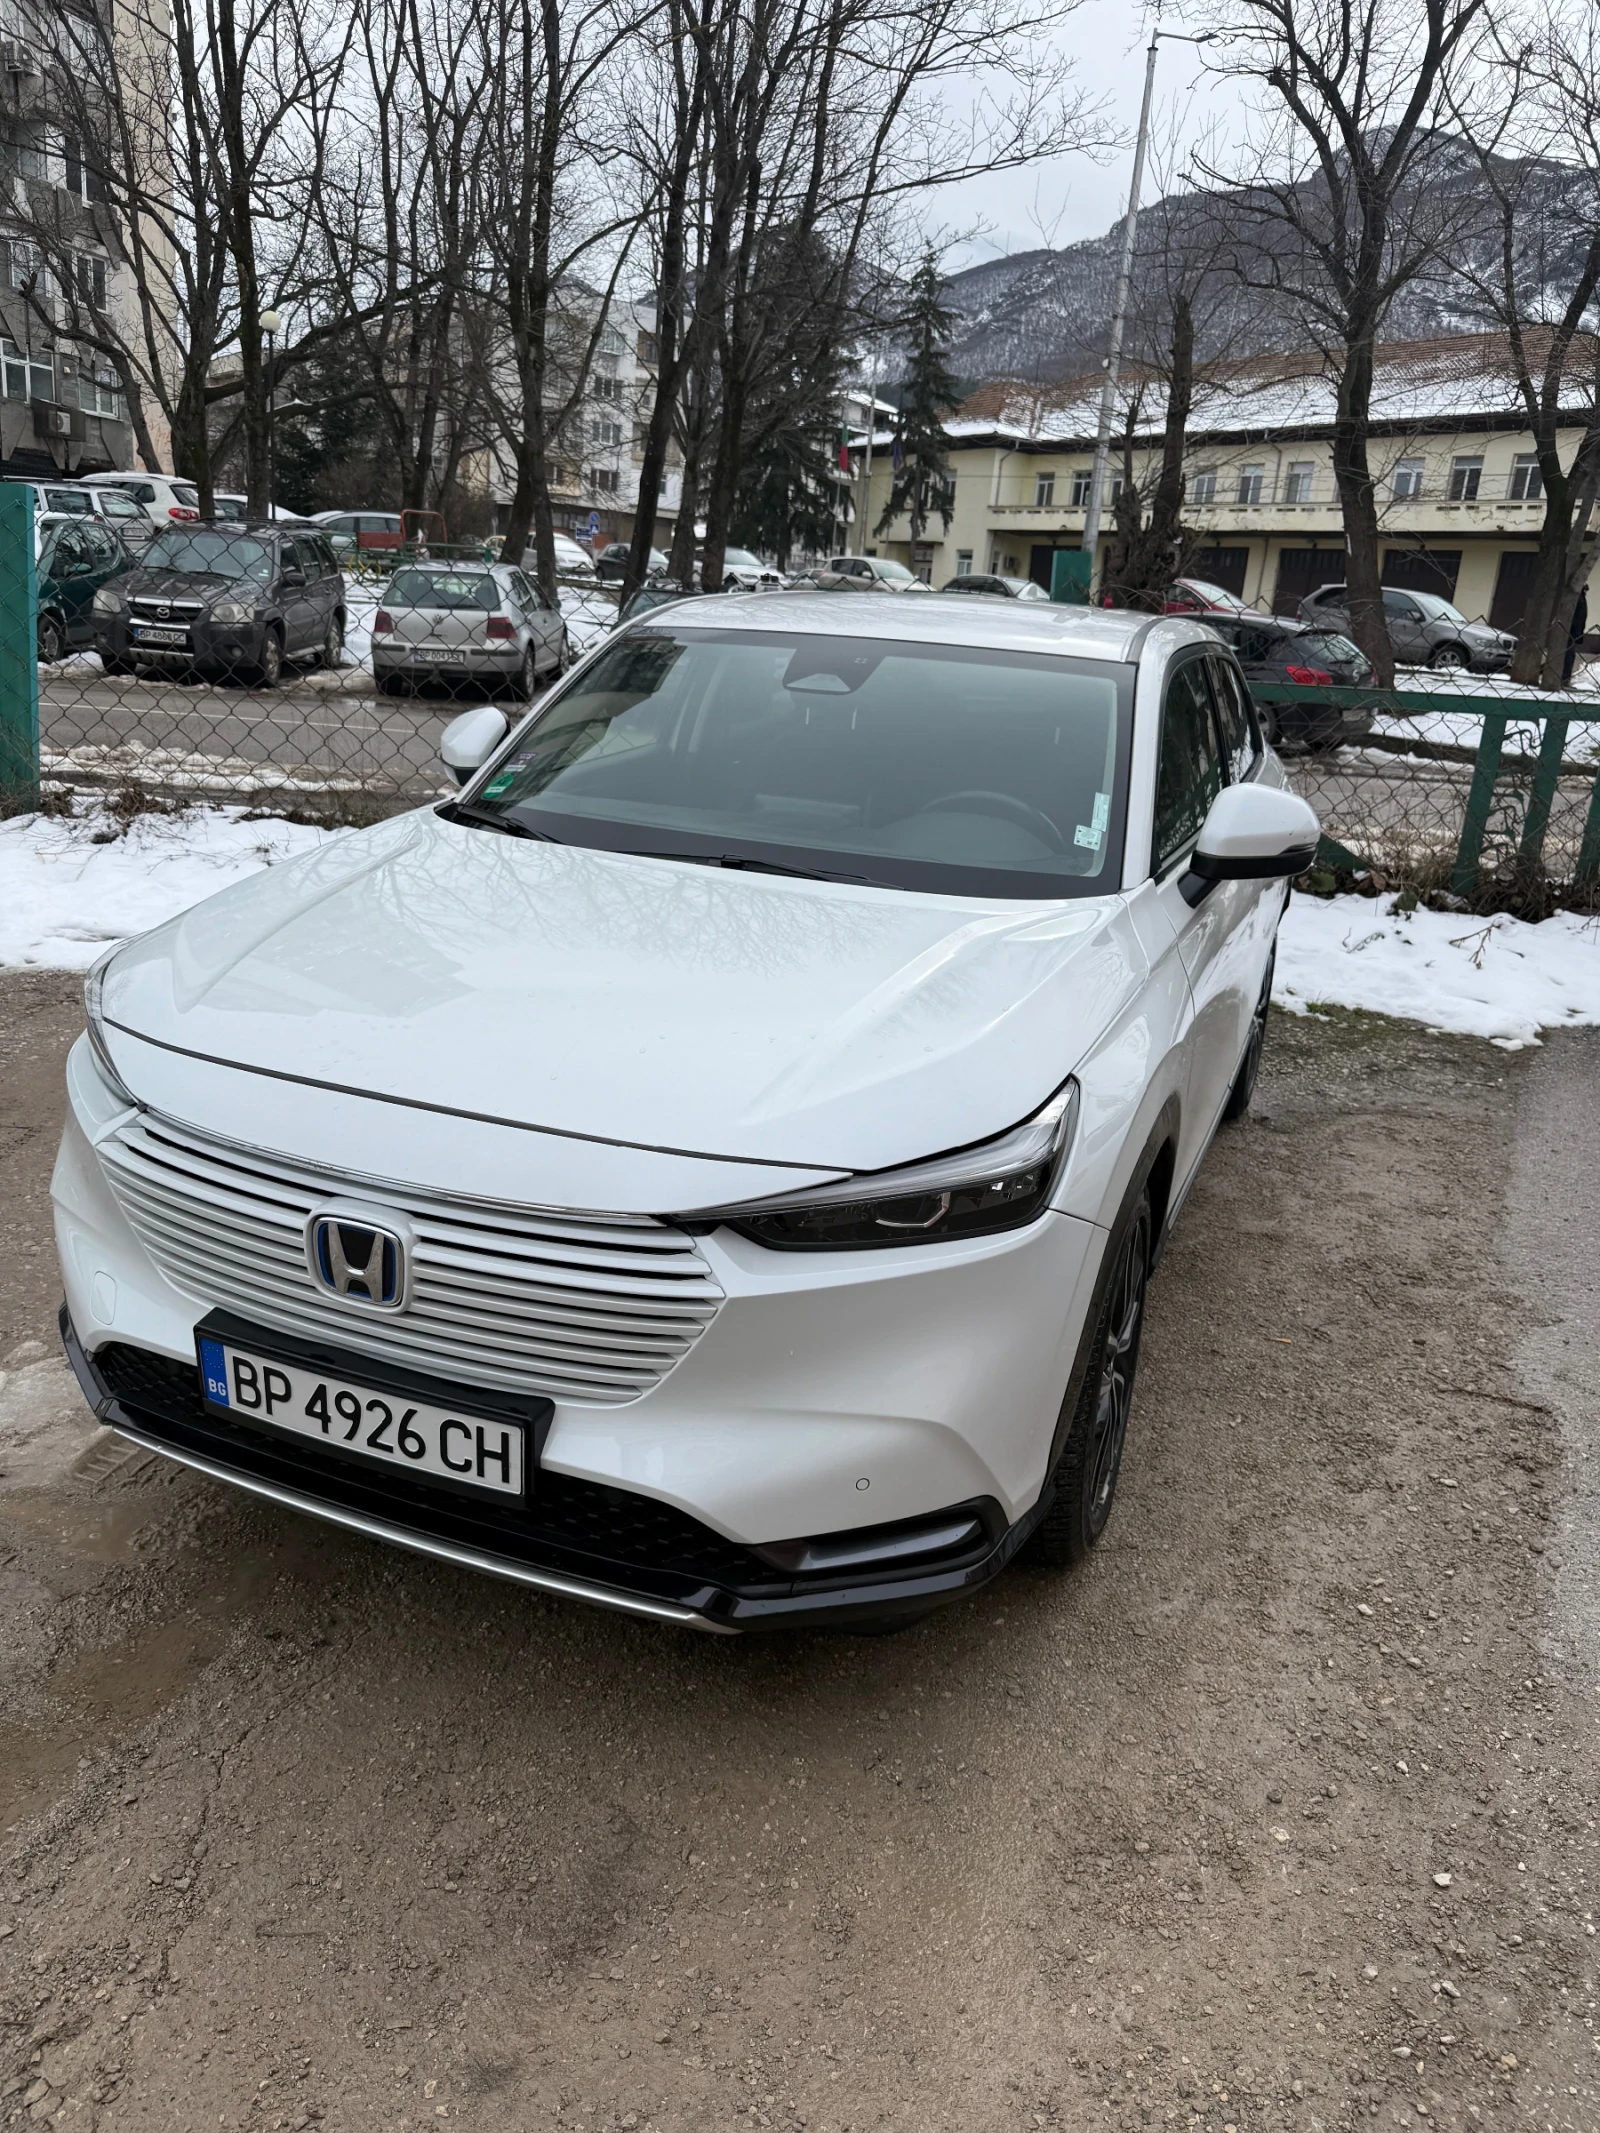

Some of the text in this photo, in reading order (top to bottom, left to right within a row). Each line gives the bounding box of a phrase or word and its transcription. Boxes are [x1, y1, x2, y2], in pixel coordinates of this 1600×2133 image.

[208, 1377, 227, 1396] BG
[232, 1355, 510, 1483] BP 4926 CH
